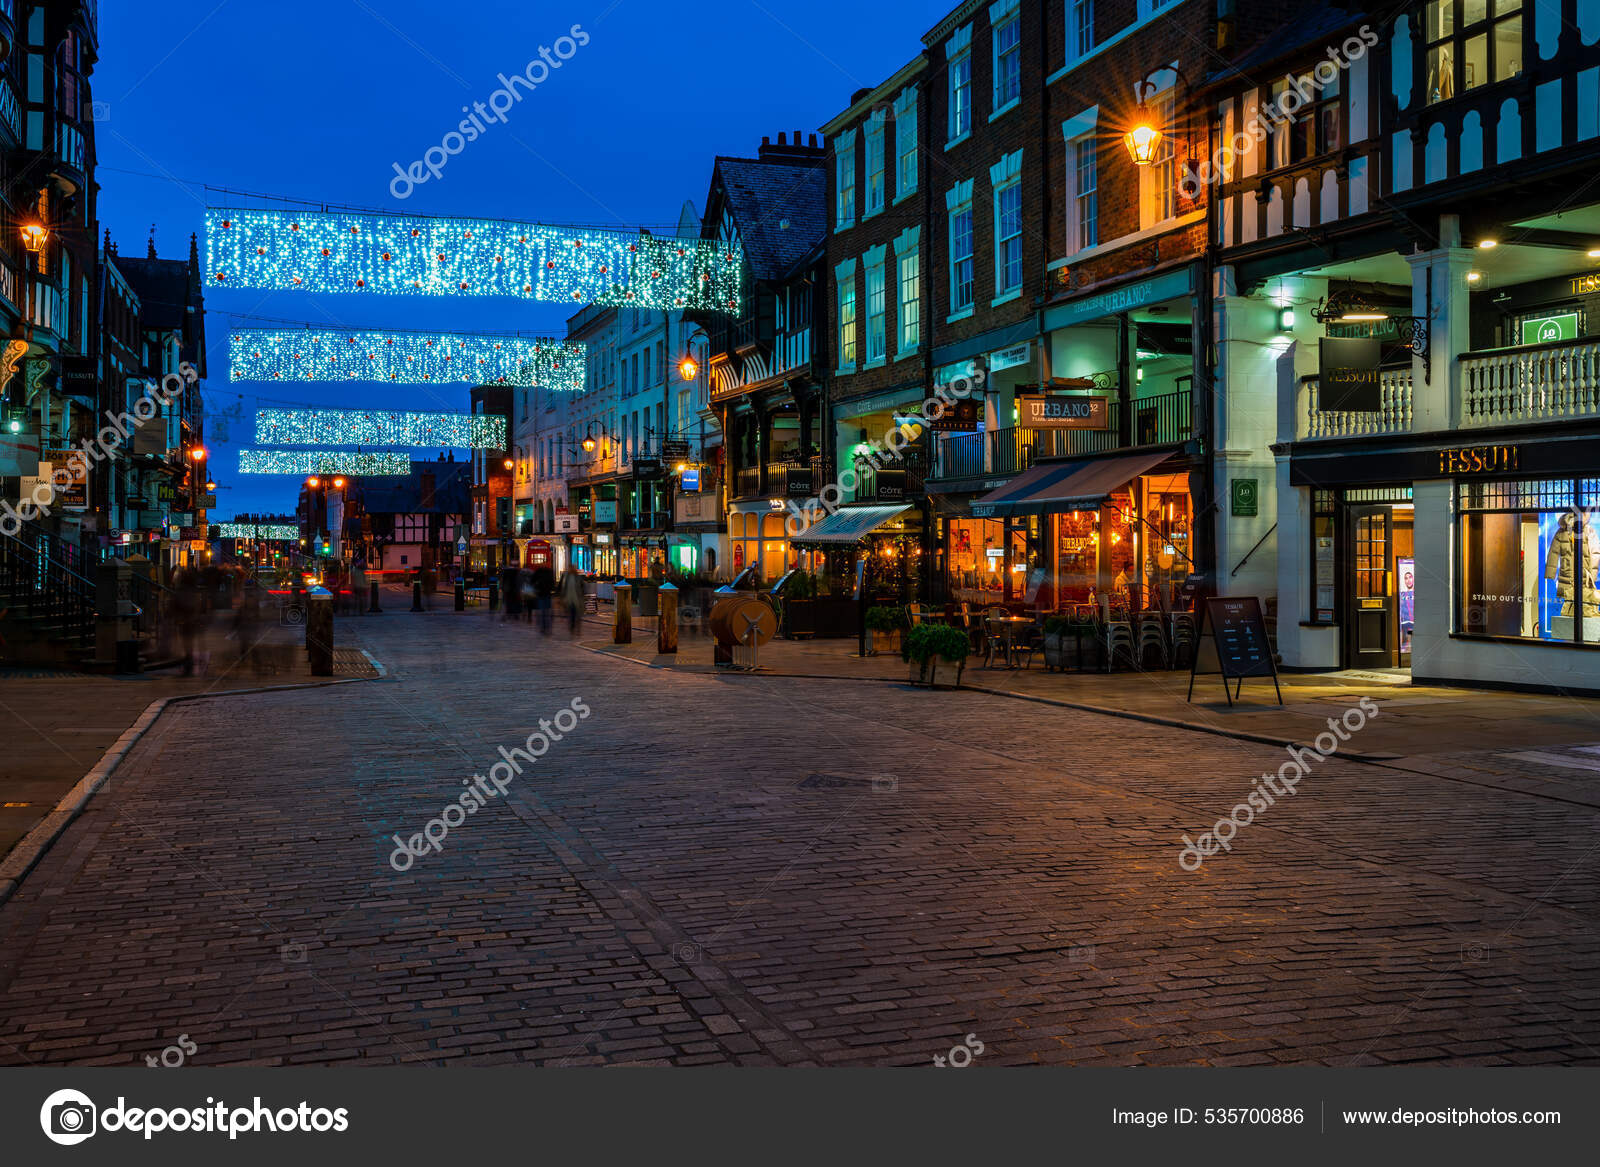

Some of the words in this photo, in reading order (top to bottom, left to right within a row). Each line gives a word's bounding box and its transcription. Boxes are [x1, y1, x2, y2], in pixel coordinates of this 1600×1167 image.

[1328, 367, 1377, 383] TESSUTI
[1437, 445, 1518, 473] TESSUTI
[1499, 595, 1515, 603] OUT
